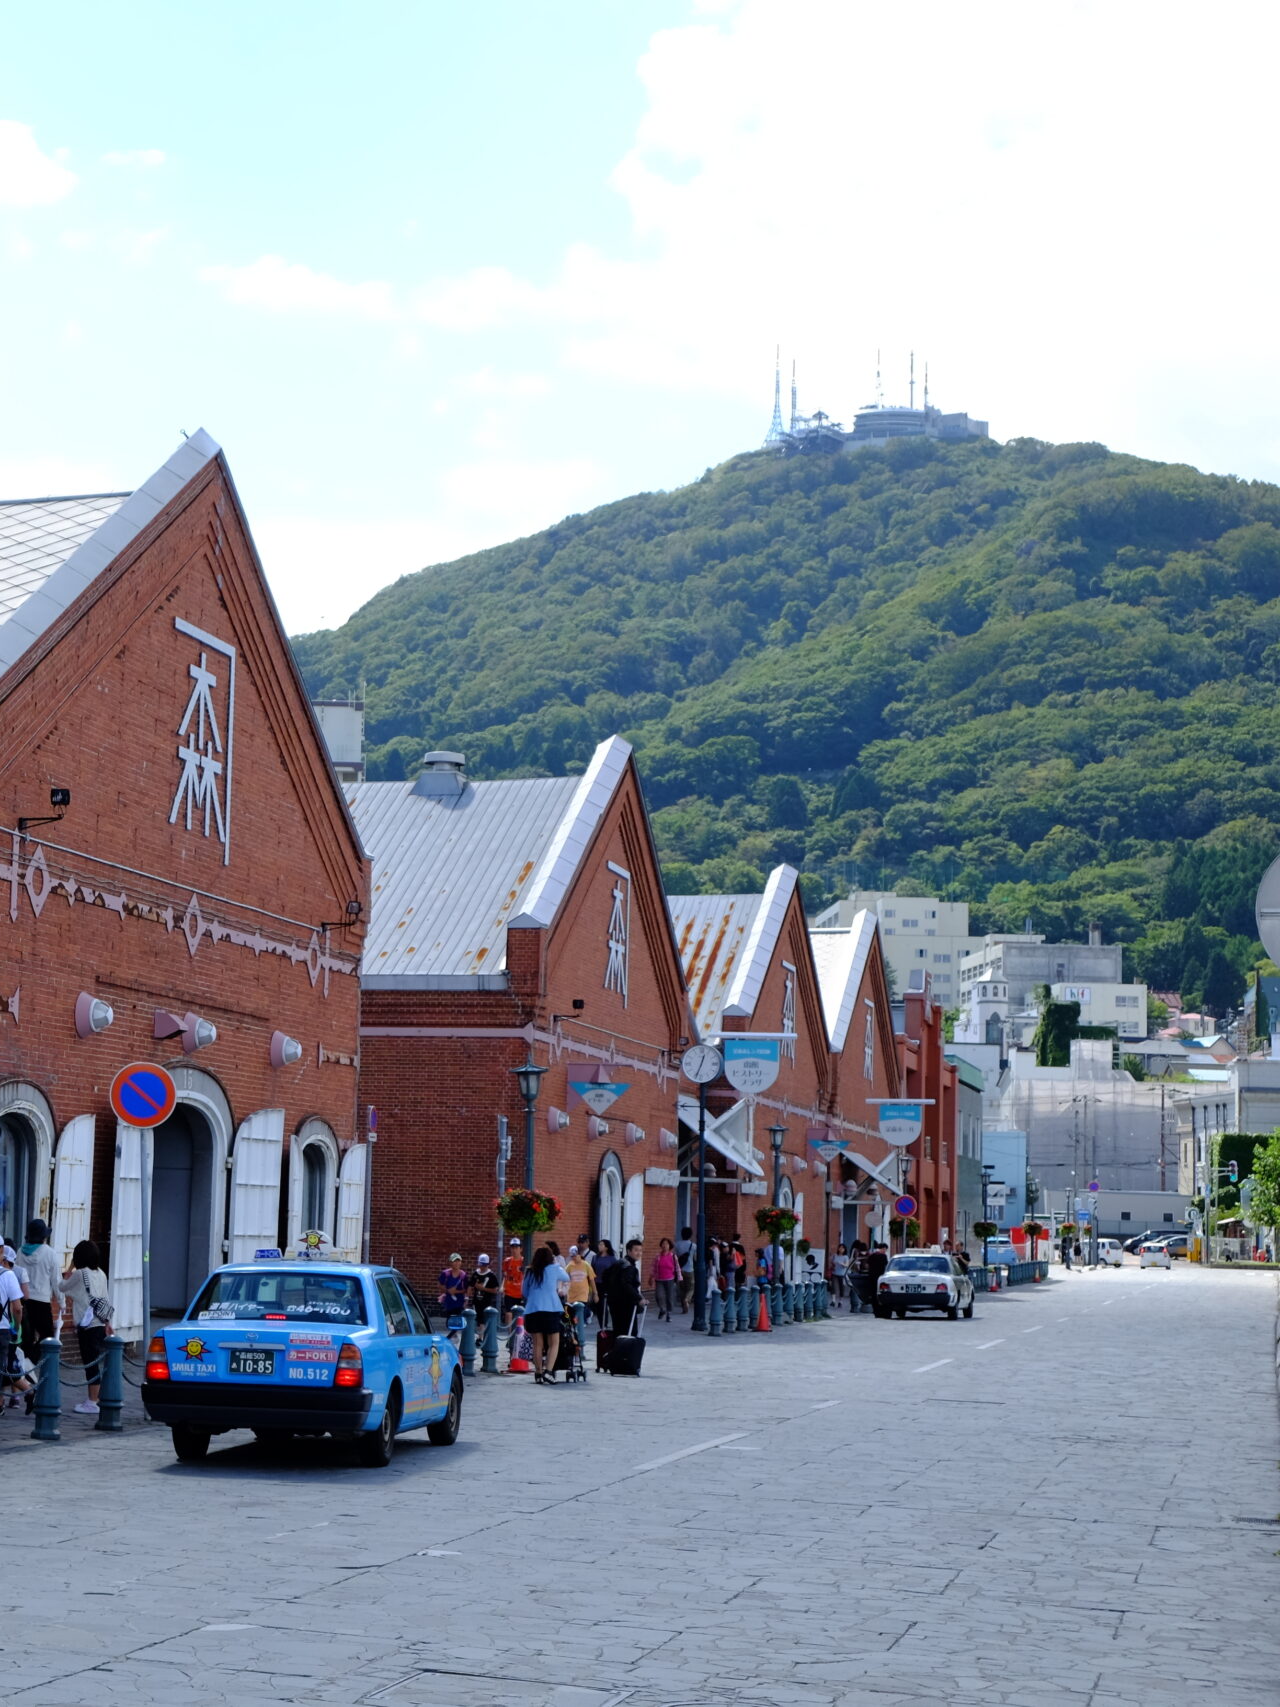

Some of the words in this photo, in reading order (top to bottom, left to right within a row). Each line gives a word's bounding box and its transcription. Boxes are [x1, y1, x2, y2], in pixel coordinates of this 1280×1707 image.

[183, 1068, 193, 1090] 15
[289, 1351, 333, 1361] カードOK!!
[171, 1362, 195, 1372] SMILE
[196, 1363, 216, 1373] TAXI
[240, 1359, 273, 1374] 10-85
[289, 1367, 329, 1380] NO.512
